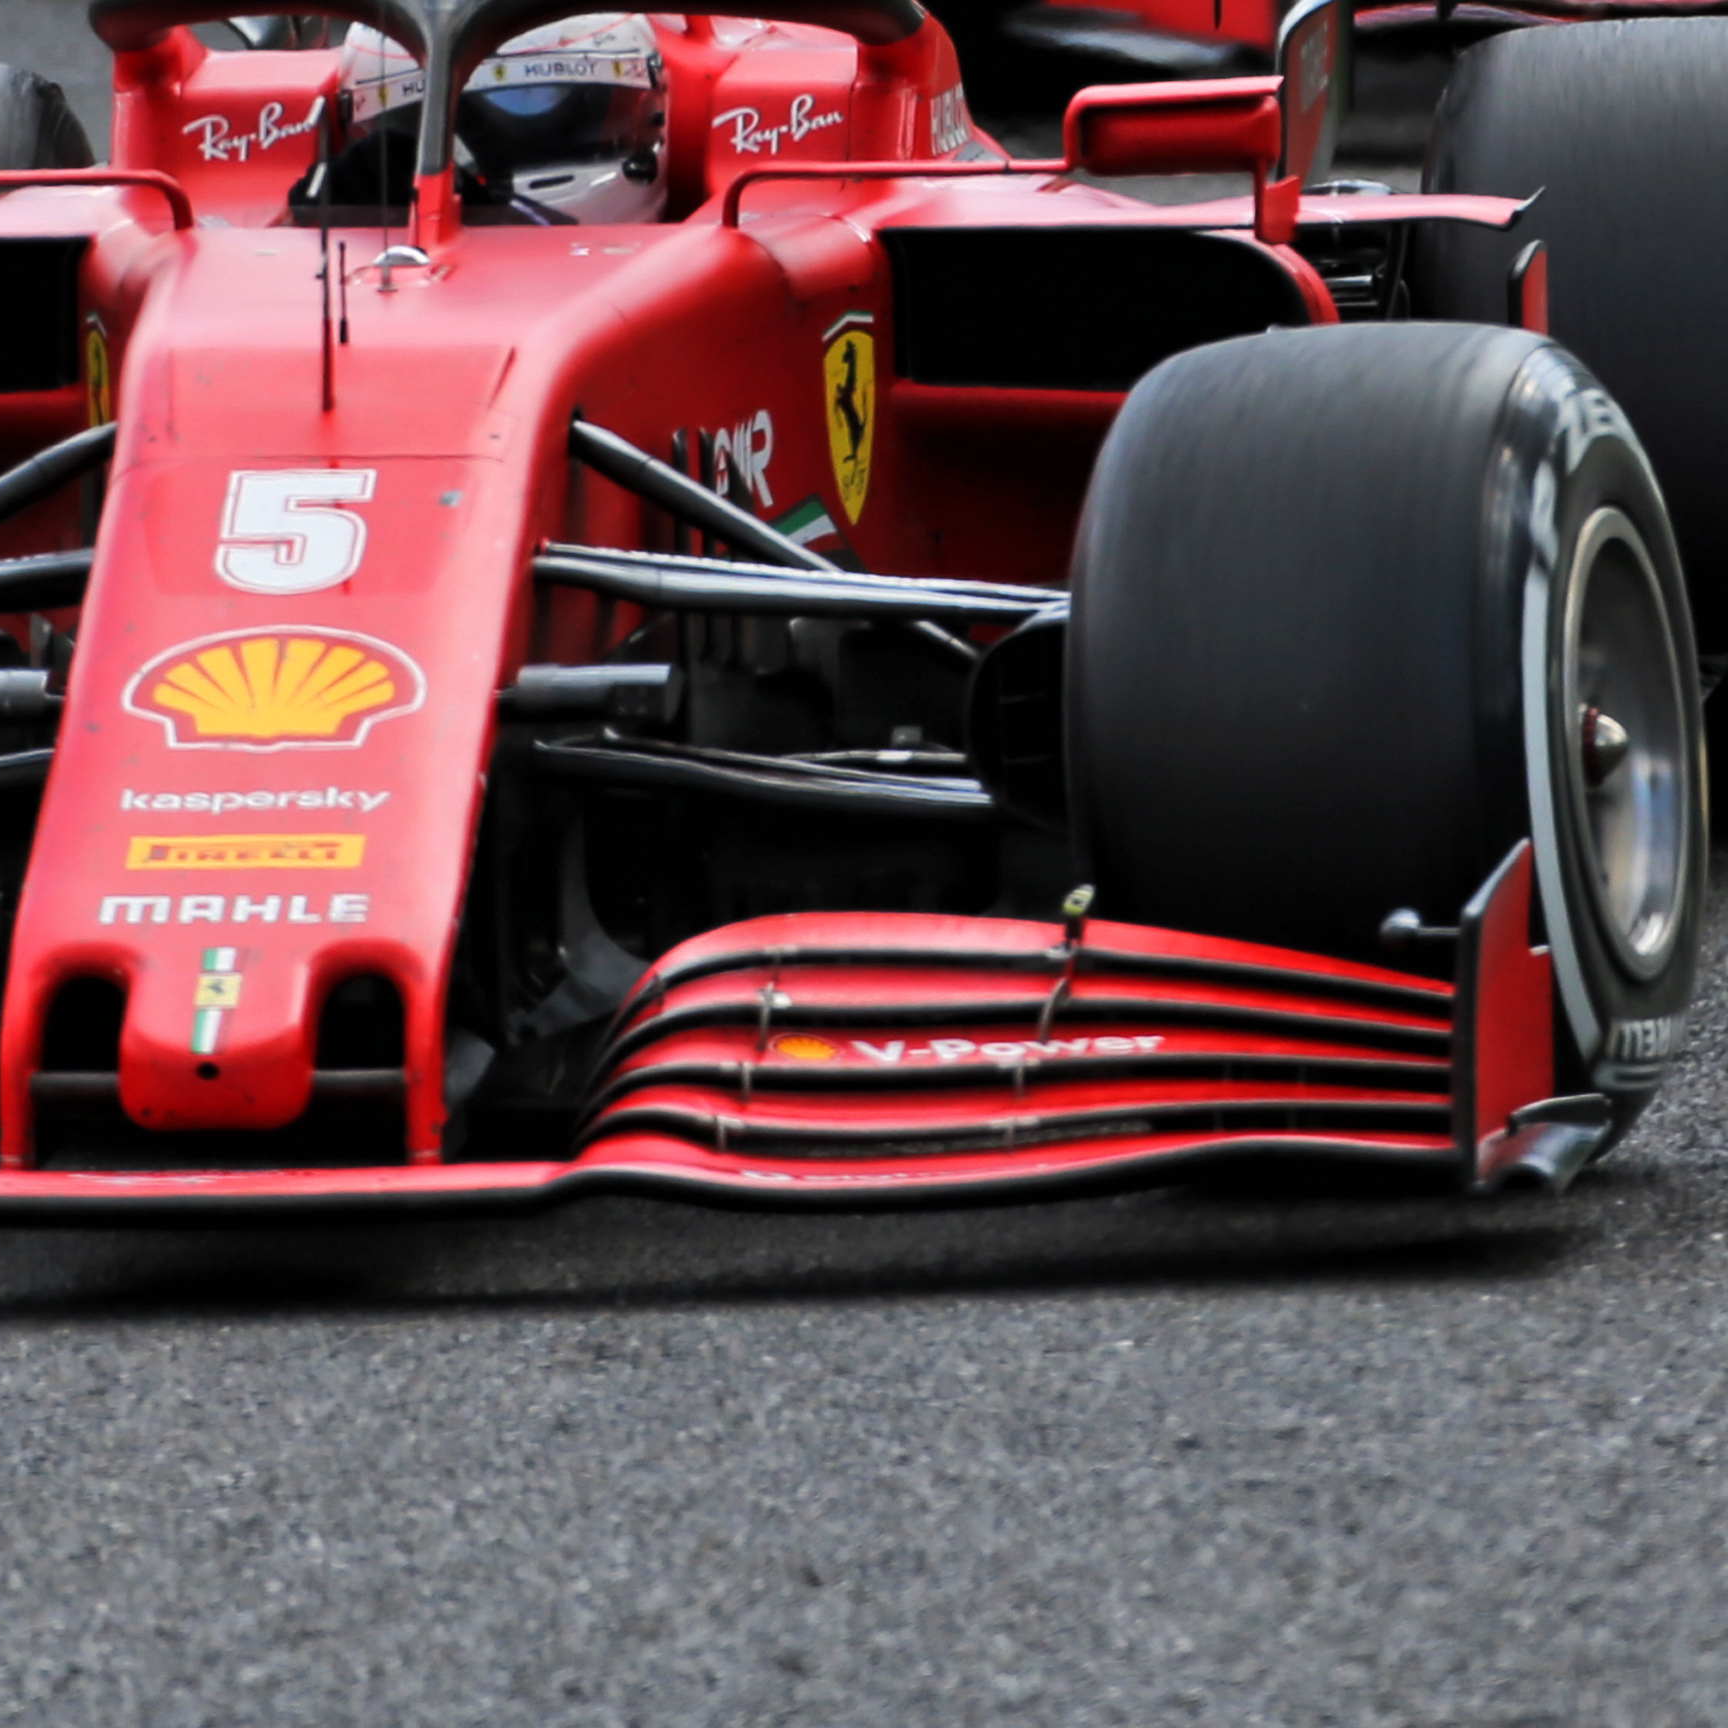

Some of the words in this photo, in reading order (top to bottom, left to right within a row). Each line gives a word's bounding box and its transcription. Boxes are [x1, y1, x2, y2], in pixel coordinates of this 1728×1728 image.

[524, 60, 598, 79] HUBLOT
[183, 101, 318, 162] Ray-Ban
[711, 94, 844, 155] Ray-Ban
[214, 468, 378, 597] 5
[121, 786, 390, 815] kaspersky
[98, 893, 371, 925] MAHLE
[851, 1036, 1167, 1064] V-Power
